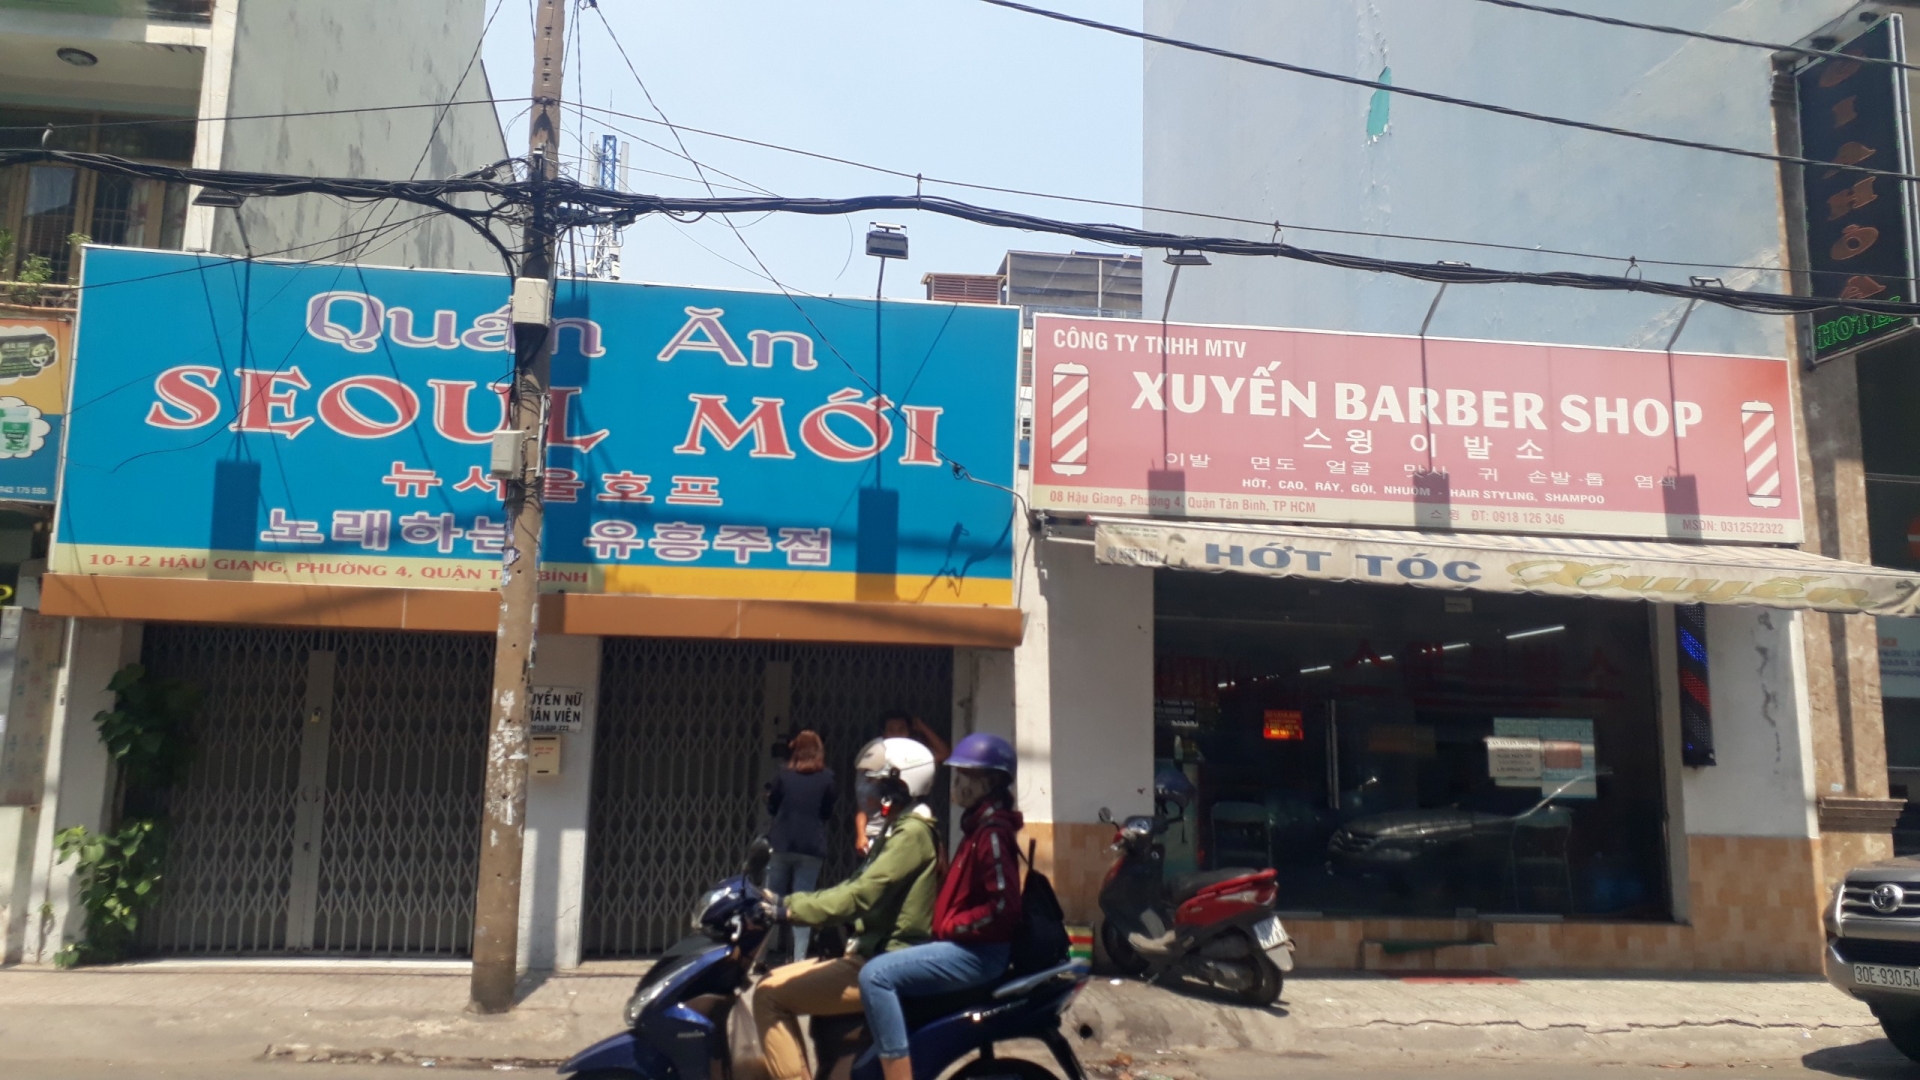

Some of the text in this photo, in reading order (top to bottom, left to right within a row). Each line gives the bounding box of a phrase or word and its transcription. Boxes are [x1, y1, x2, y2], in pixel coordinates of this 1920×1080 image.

[306, 289, 818, 371] Quán Ăn
[1053, 326, 1247, 358] CÔNG TY TNHH MTV
[1131, 360, 1703, 438] XUYẾN BARBER SHOP
[144, 364, 945, 468] SEOUL MỚI
[1165, 453, 1211, 468] 이발
[1251, 456, 1297, 471] 면도
[1049, 490, 1063, 502] 08
[1067, 491, 1089, 505] Hậu
[1188, 496, 1216, 511] Quận
[1219, 497, 1239, 510] Tân
[1273, 500, 1287, 512] TP
[1290, 501, 1316, 513] HCM
[1450, 488, 1480, 499] HAIR
[1545, 492, 1605, 505] SHAMPOO
[1492, 511, 1519, 523] 0918
[1523, 513, 1542, 524] 126
[1545, 513, 1565, 525] 346
[1721, 521, 1784, 535] 0312522322
[89, 553, 151, 568] 10-12
[158, 553, 206, 572] HẬU
[213, 557, 289, 575] GIANG,
[295, 558, 387, 577] PHƯỜNG
[420, 564, 482, 581] QUẬN
[1205, 541, 1332, 572] HỚT
[1355, 551, 1482, 583] TÓC
